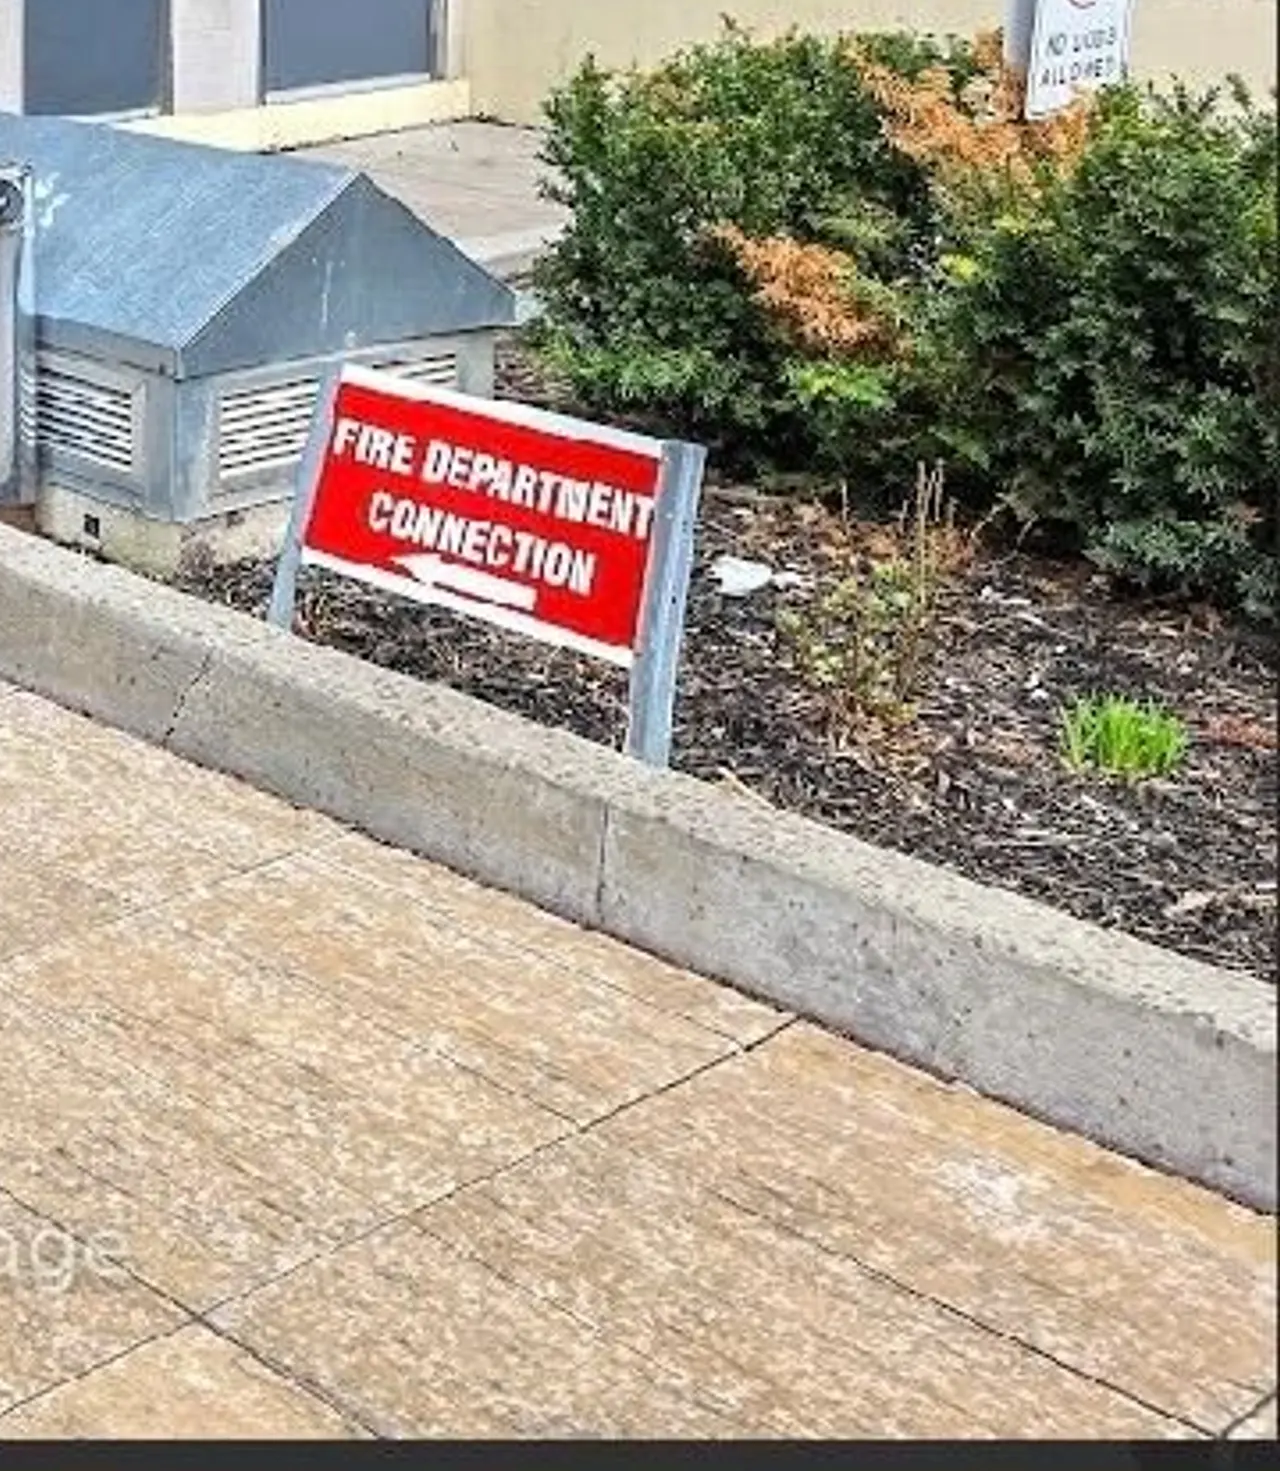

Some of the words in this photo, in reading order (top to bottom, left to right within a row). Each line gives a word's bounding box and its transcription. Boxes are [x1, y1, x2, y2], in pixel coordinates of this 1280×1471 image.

[1045, 32, 1068, 57] NO
[333, 418, 416, 474] FIRE
[421, 438, 654, 540] DEPARTMENT
[368, 490, 596, 596] CONNECTION
